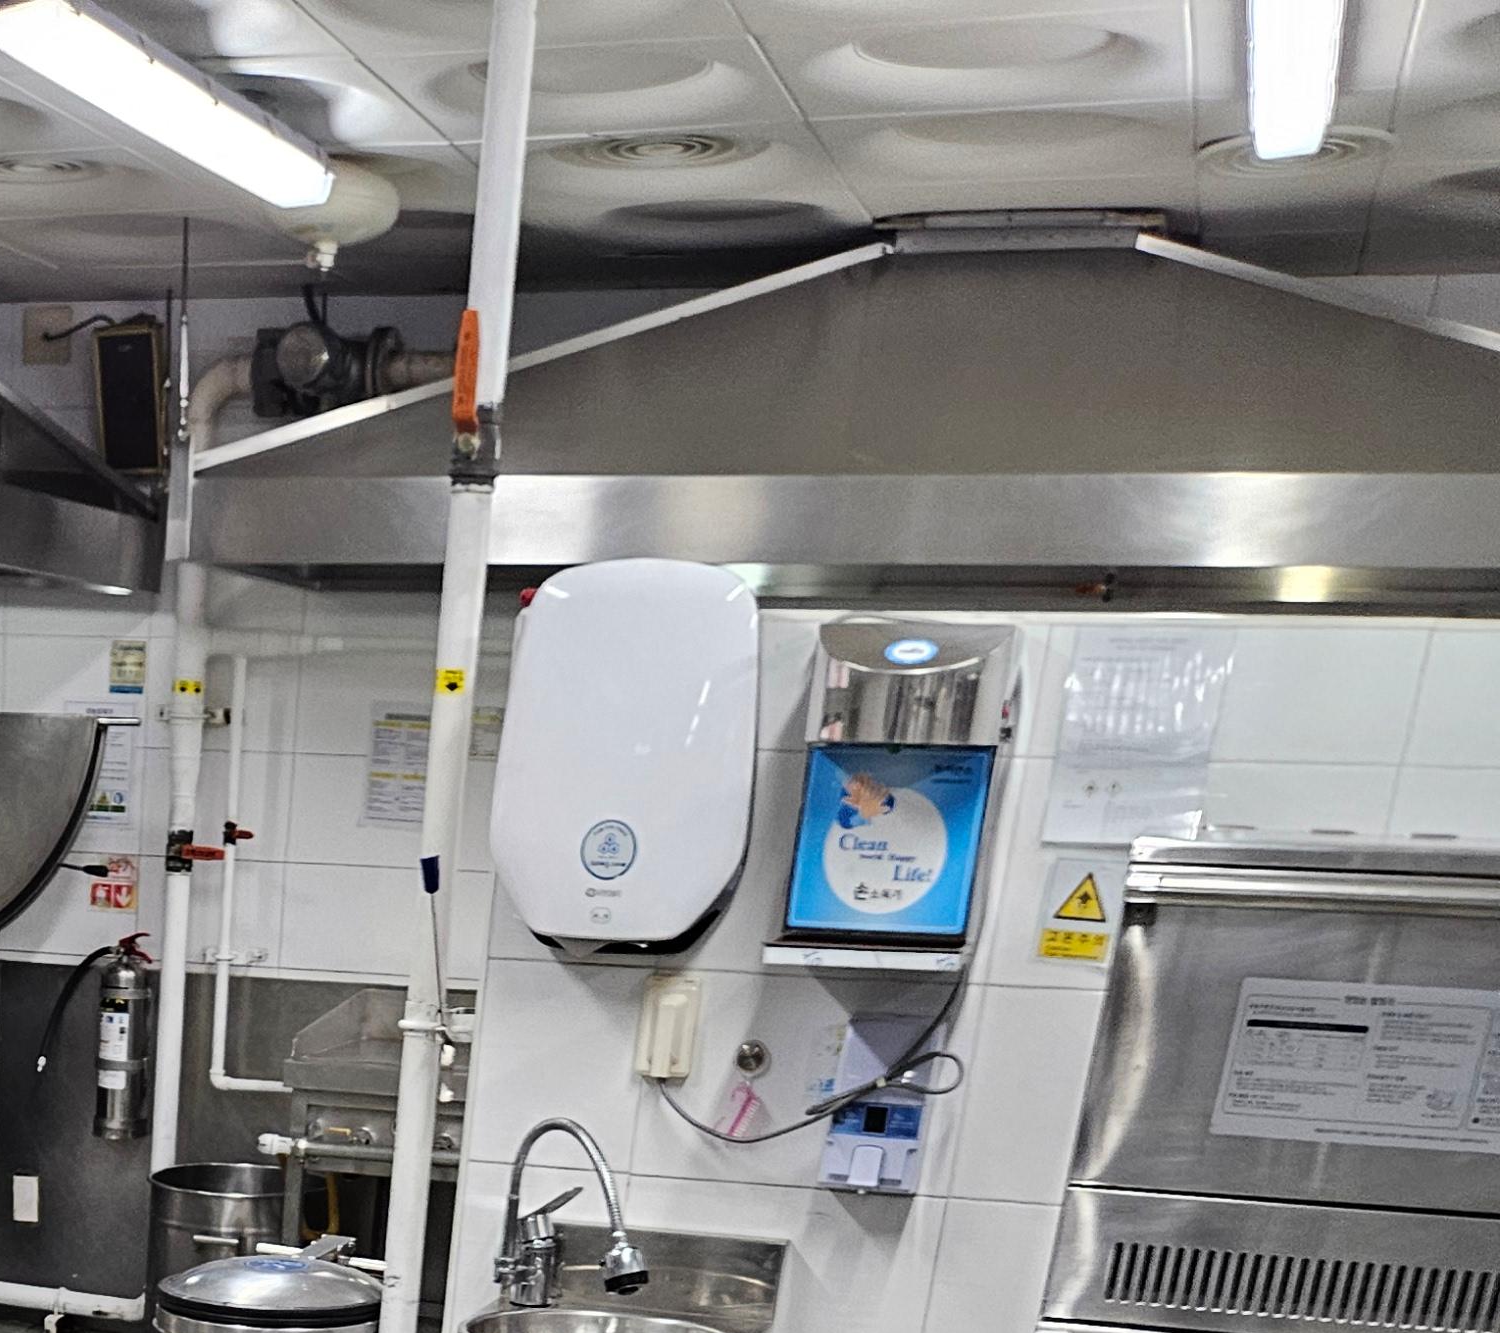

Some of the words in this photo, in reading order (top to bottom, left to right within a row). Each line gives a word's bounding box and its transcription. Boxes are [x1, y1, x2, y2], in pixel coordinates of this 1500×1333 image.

[838, 834, 889, 851] Clean
[892, 864, 933, 883] Life!
[853, 881, 904, 901] 손소독기
